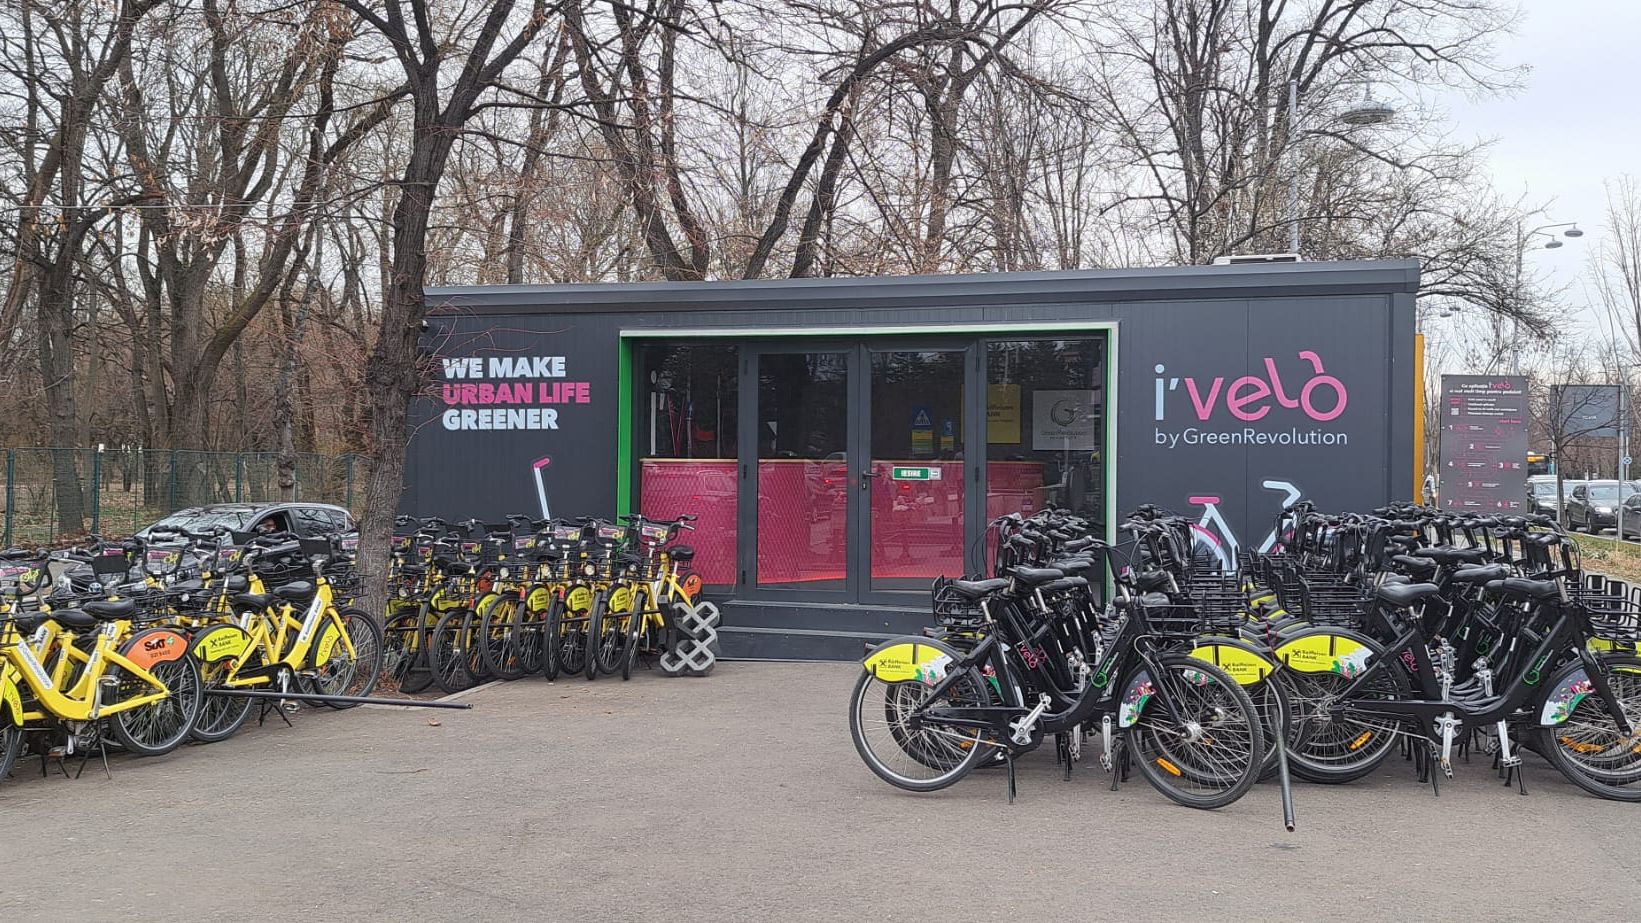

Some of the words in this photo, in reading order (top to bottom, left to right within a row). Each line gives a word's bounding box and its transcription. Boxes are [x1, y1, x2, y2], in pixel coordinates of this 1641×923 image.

[442, 357, 483, 379] WE
[489, 356, 566, 378] MAKE
[442, 382, 533, 405] URBAN
[539, 382, 591, 404] LIFE
[442, 408, 559, 430] GREENER
[1155, 428, 1180, 449] by
[1183, 428, 1348, 445] GreenRevolution
